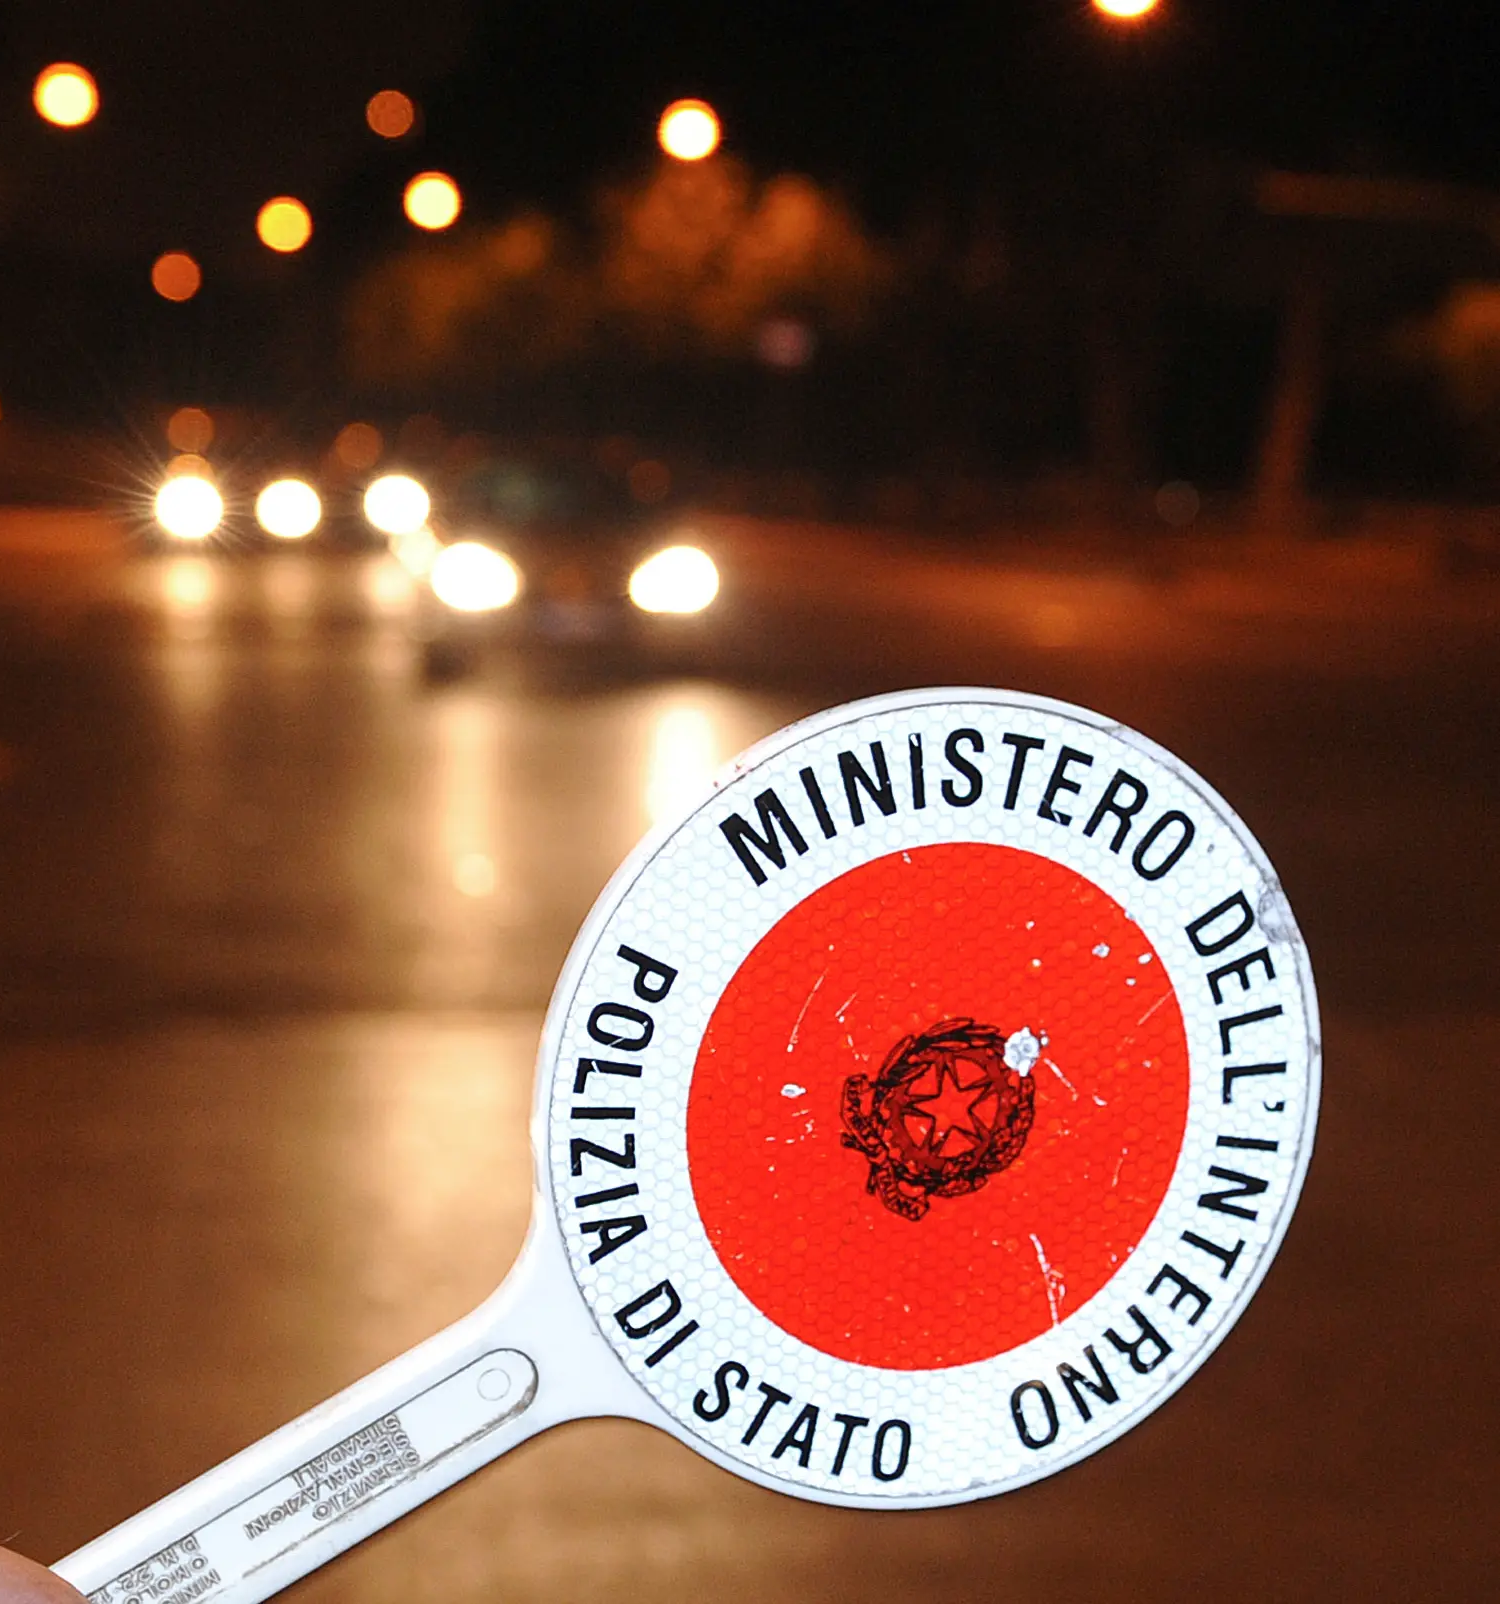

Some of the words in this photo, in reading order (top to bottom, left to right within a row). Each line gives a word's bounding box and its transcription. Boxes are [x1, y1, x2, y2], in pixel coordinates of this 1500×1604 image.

[569, 944, 679, 1265] POLIZIA
[718, 728, 1197, 887] MINISTERO
[1010, 889, 1288, 1451] DELL'INTERNO
[613, 1278, 700, 1368] DI
[291, 1413, 401, 1488] STRADALI
[692, 1360, 912, 1482] STATO
[243, 1430, 410, 1540] SEGNALAZIONI
[312, 1448, 420, 1521] SERVIZIO
